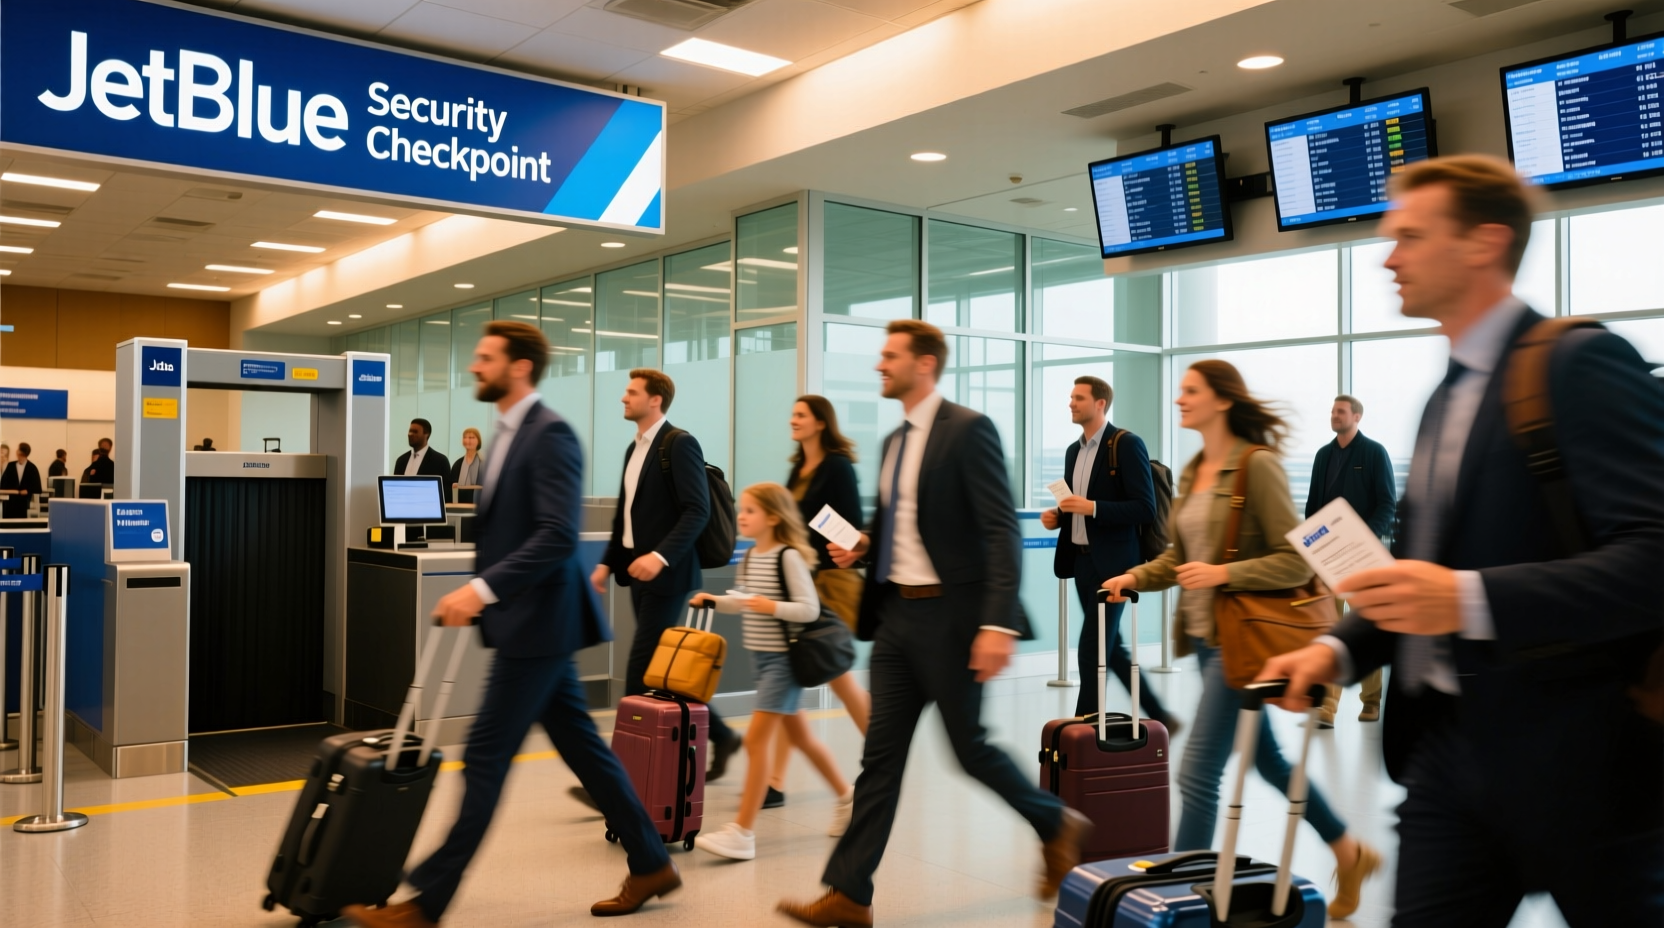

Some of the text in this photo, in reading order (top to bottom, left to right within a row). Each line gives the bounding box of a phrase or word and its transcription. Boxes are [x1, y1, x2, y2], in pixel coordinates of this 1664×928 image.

[37, 30, 349, 151] JetBlue
[367, 81, 507, 143] Security
[366, 125, 551, 184] Checkpoint
